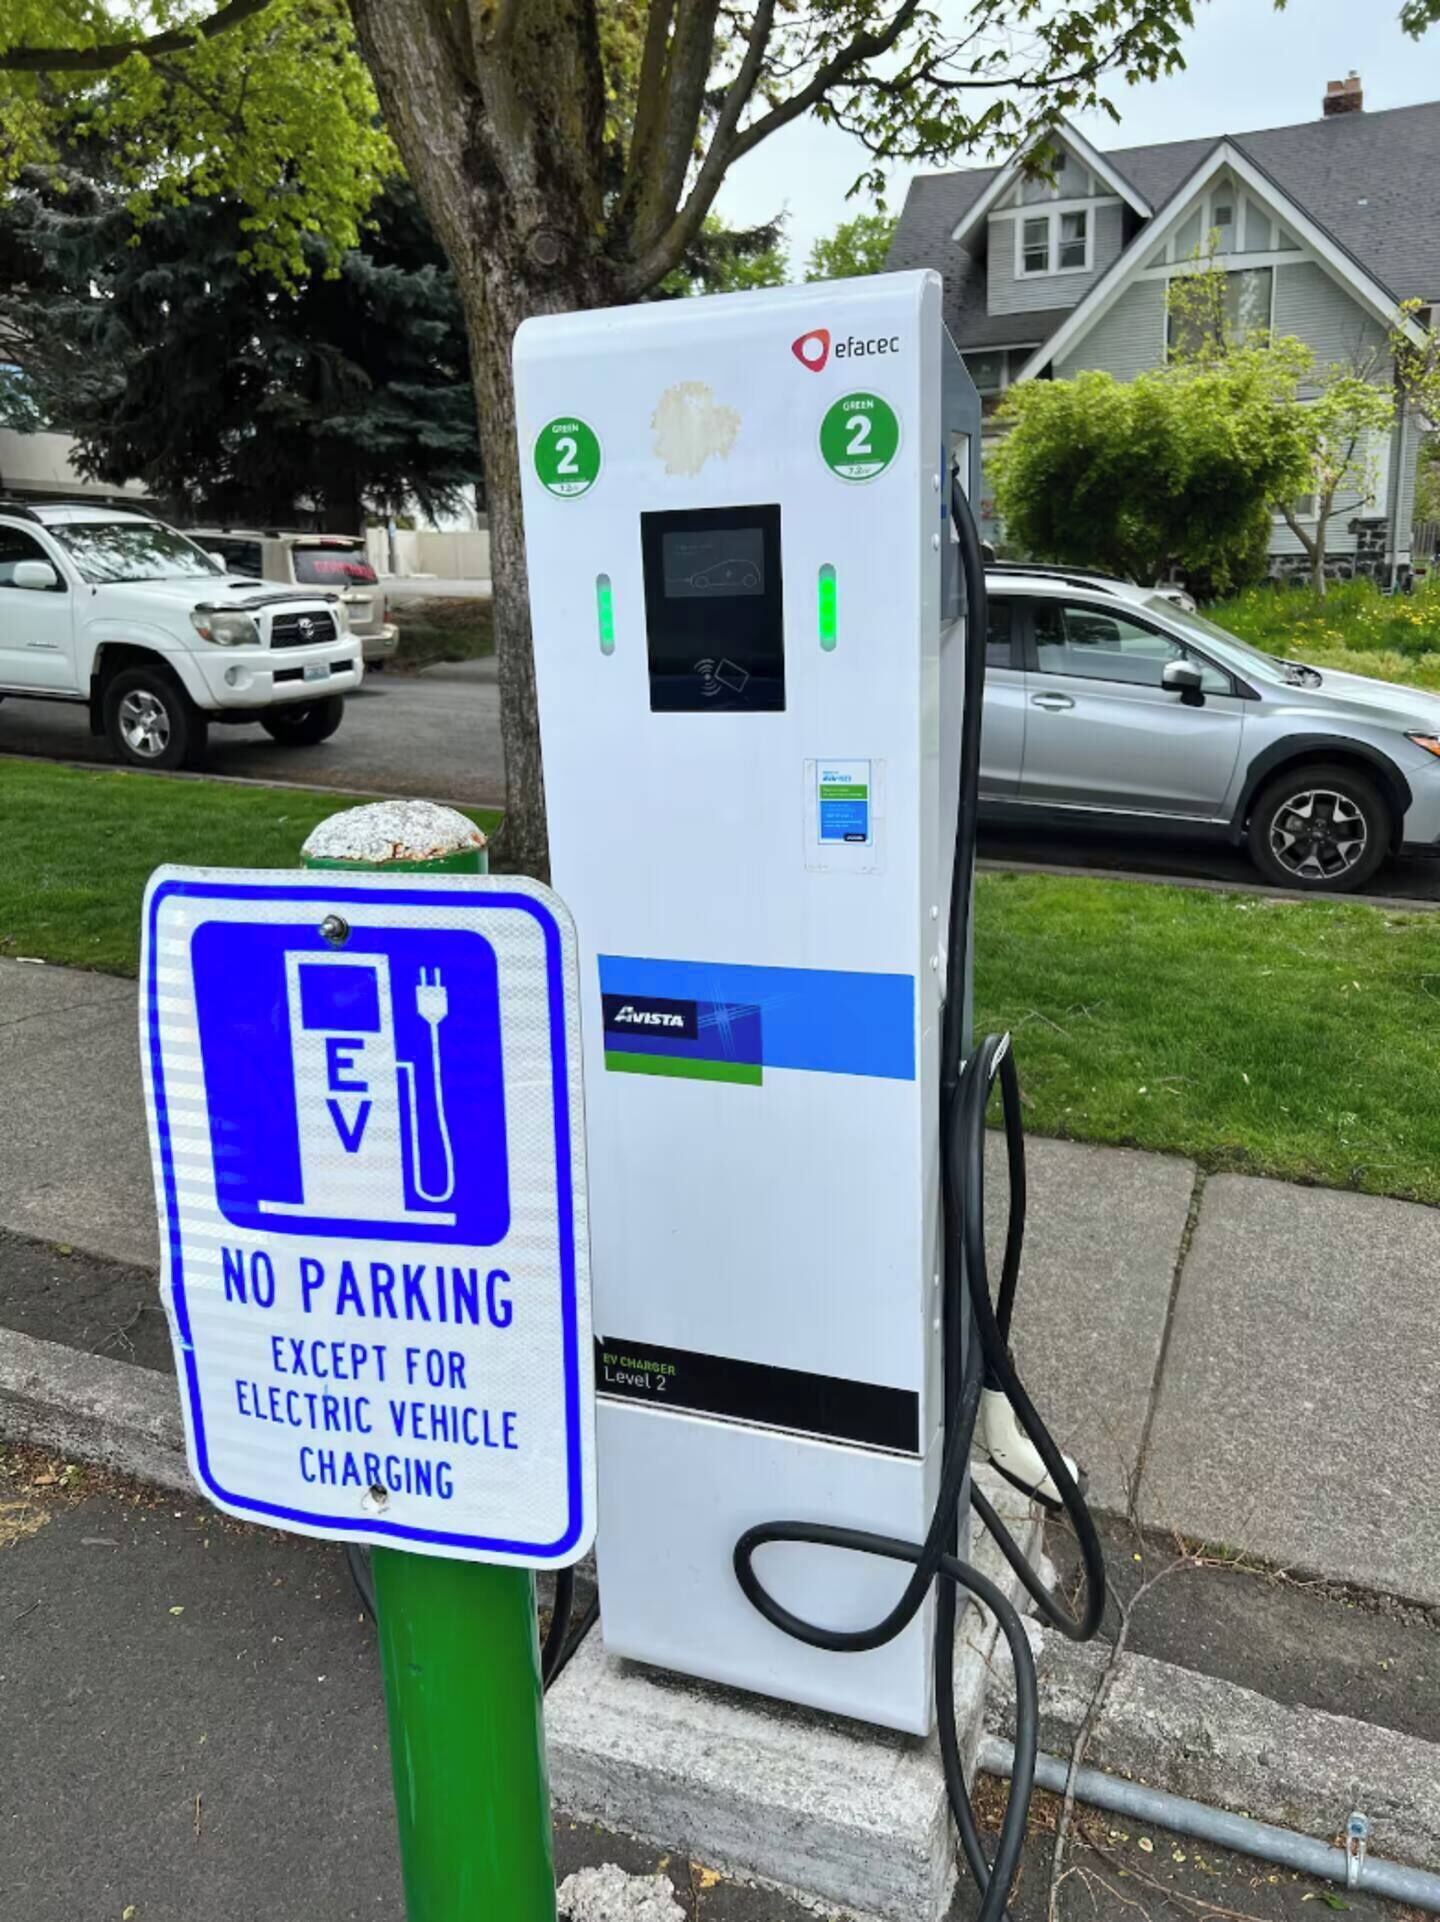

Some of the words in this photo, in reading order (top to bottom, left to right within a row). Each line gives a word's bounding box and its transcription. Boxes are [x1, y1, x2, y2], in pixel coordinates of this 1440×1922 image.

[835, 336, 899, 358] efacec
[843, 400, 875, 411] GREEN
[552, 424, 580, 434] GREEN
[846, 415, 872, 455] 2
[556, 437, 579, 474] 2
[614, 1005, 684, 1028] AVISTA
[221, 1246, 276, 1309] NO
[300, 1257, 513, 1328] PARKING
[271, 1336, 387, 1382] EXCEPT
[406, 1347, 467, 1390] FOR
[603, 1352, 618, 1365] EV
[620, 1355, 676, 1376] CHARGER
[604, 1366, 652, 1389] Level
[656, 1375, 668, 1391] 2
[236, 1380, 373, 1434] ELECTRIC
[389, 1400, 519, 1450] VEHICLE
[300, 1446, 454, 1500] CHARGING
